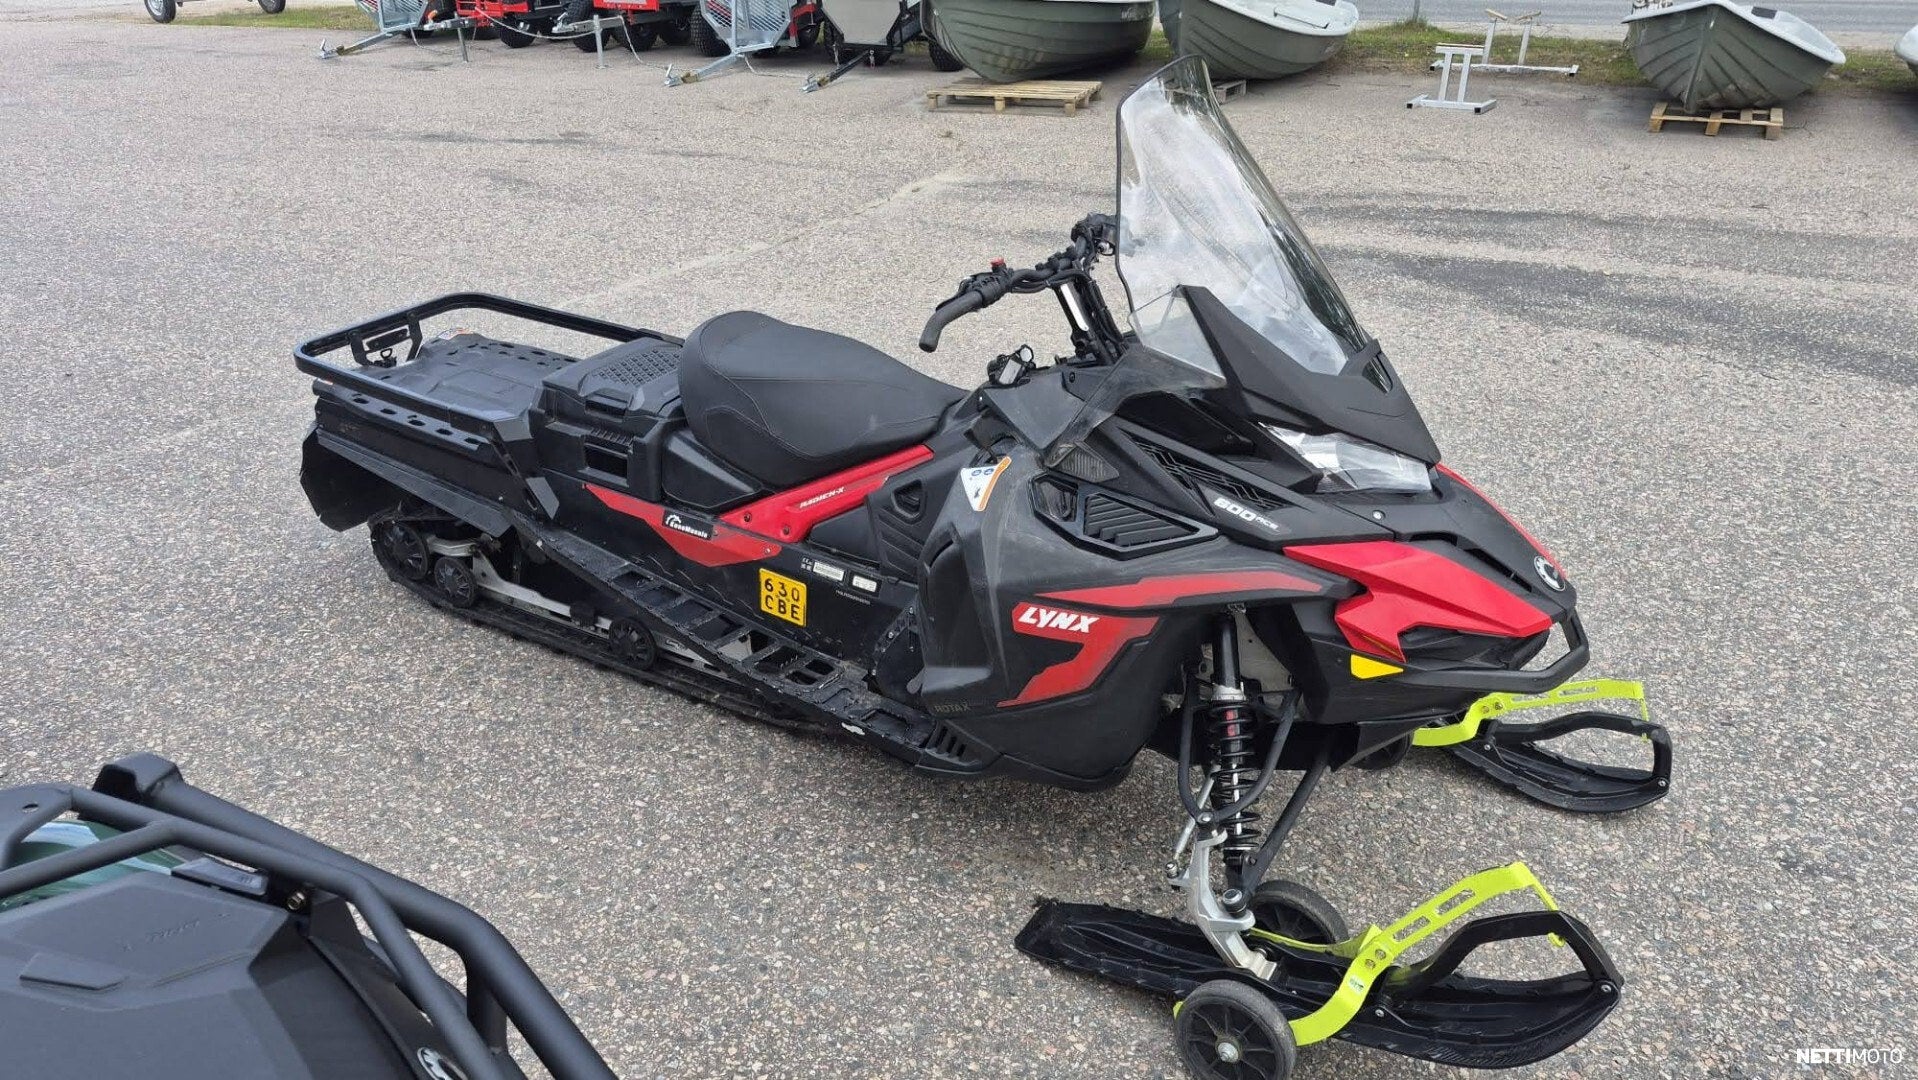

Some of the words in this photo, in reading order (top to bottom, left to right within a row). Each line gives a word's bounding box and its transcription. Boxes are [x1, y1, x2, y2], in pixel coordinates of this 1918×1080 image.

[764, 578, 800, 602] 630
[764, 594, 801, 621] CBE
[1018, 606, 1100, 634] LYNX
